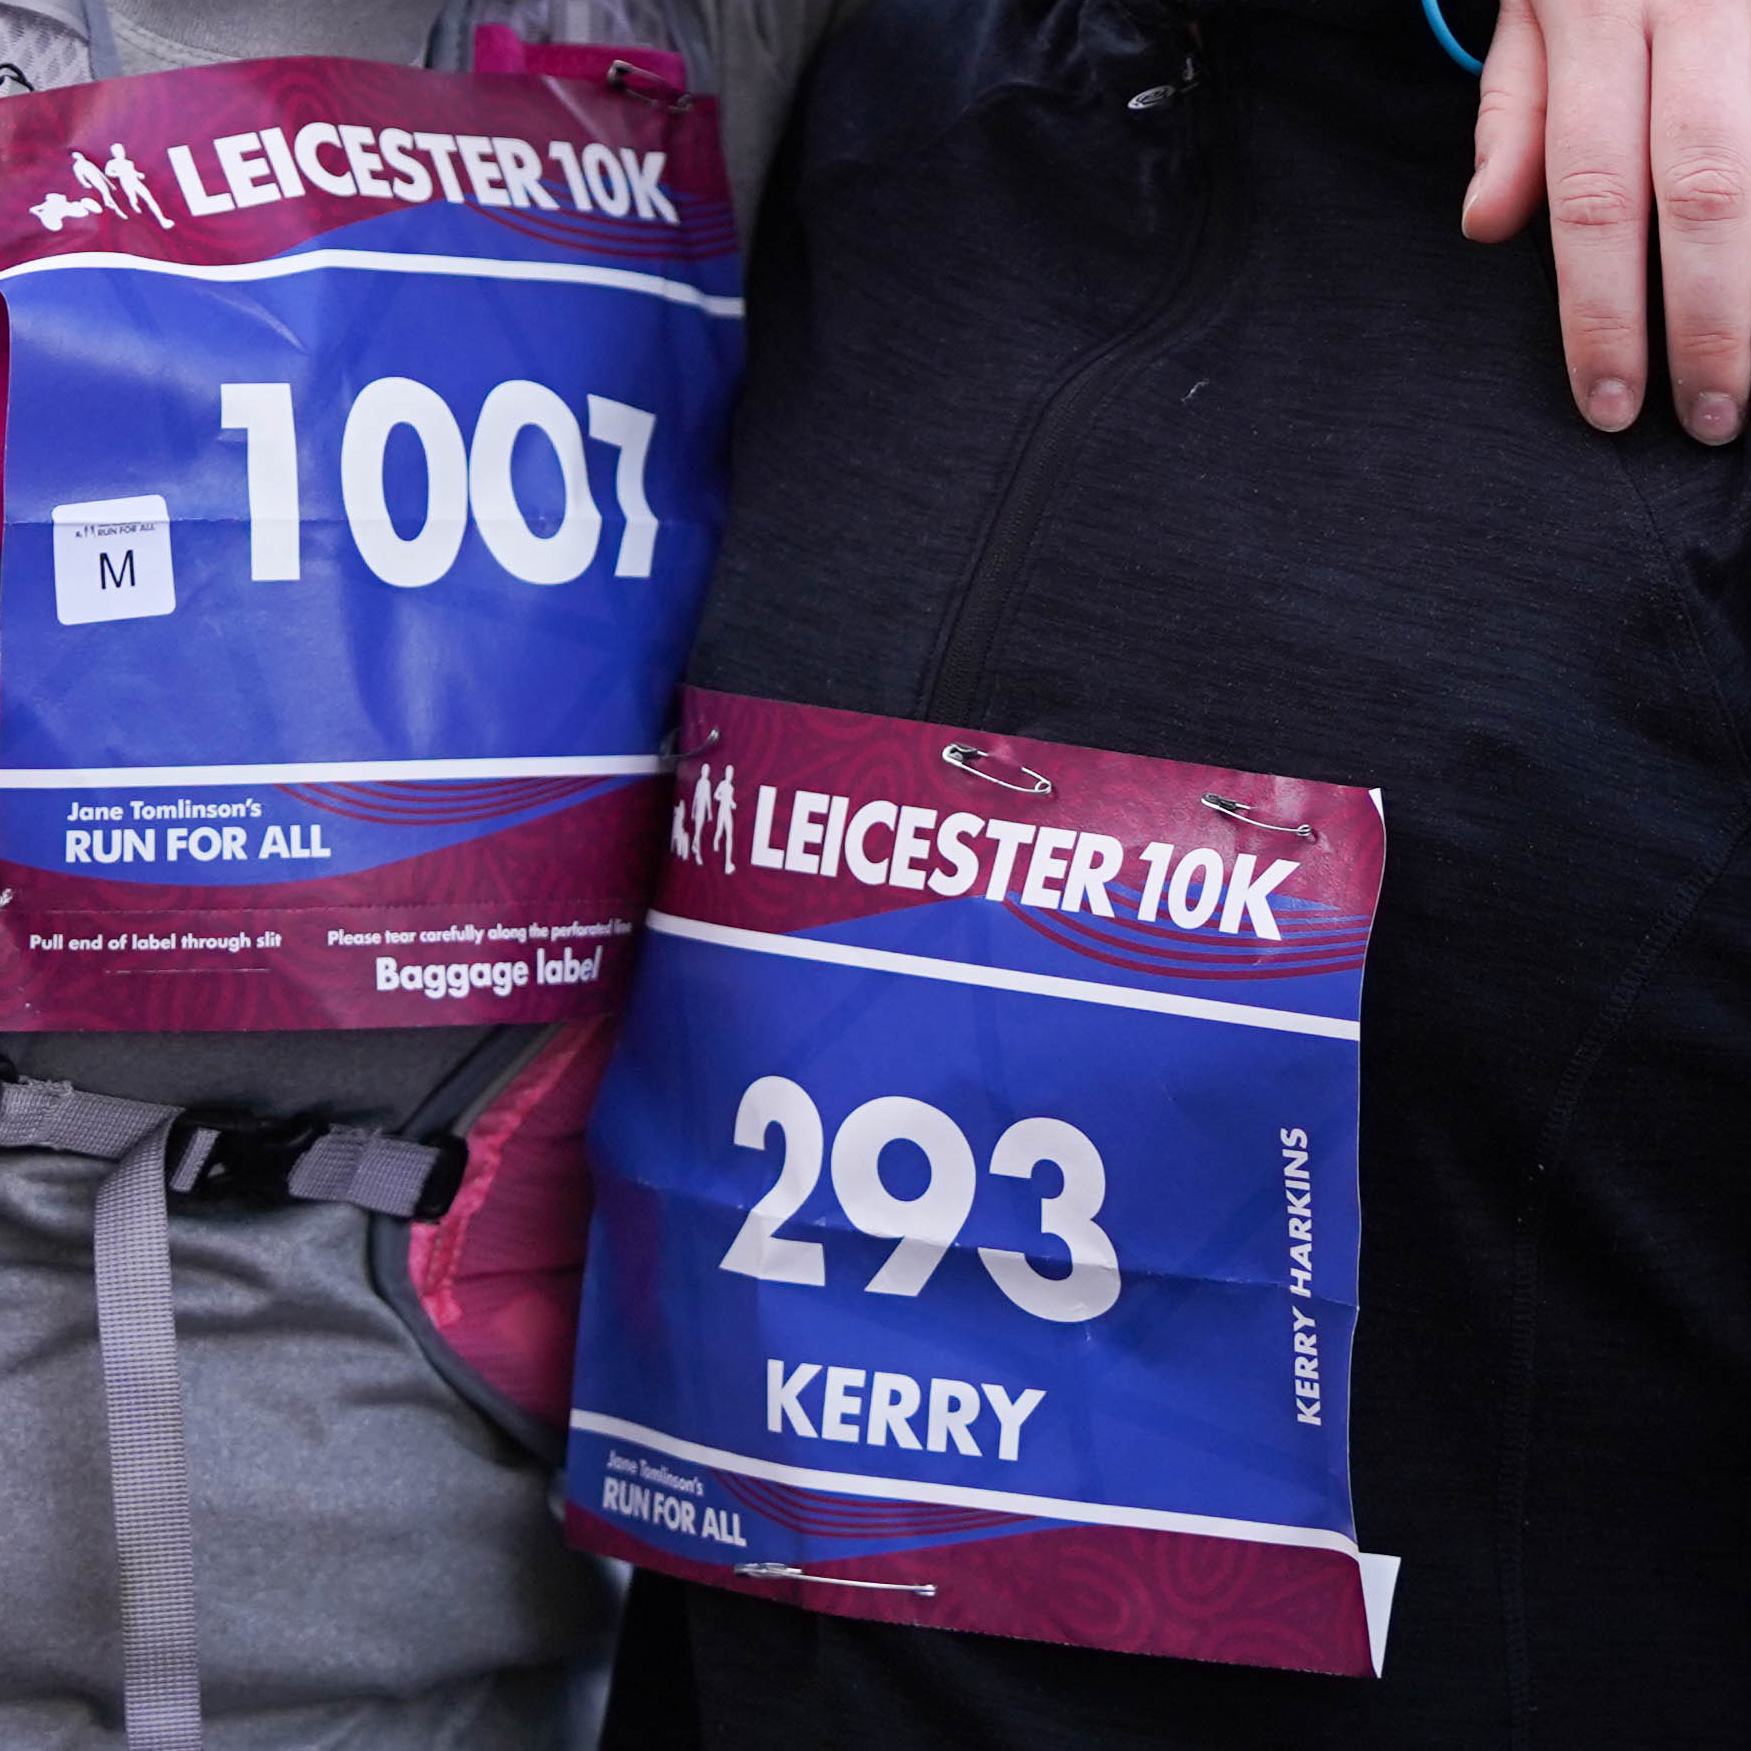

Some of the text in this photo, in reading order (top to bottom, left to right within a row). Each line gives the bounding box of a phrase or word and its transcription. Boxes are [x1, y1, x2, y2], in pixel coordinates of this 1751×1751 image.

[166, 121, 682, 225] LEICESTER 10K
[220, 376, 660, 587] 1007
[99, 549, 136, 590] M
[67, 798, 263, 821] Jane Tomlinson's
[65, 824, 332, 863] RUN FOR ALL
[750, 784, 1301, 941] LEICESTER 10K
[29, 930, 283, 953] Pull end of label through slit
[327, 928, 382, 946] Please
[385, 929, 416, 945] tear
[419, 924, 486, 945] carefully
[487, 922, 528, 943] along
[528, 921, 549, 940] the
[551, 918, 613, 942] perforated
[376, 945, 604, 999] Baggage label
[718, 1075, 1122, 1323] 293
[1280, 1126, 1322, 1427] KERRY HARKINS
[766, 1358, 1047, 1461] KERRY
[606, 1450, 704, 1497] Jane Tomlinson's
[602, 1476, 748, 1547] RUN FOR ALL
